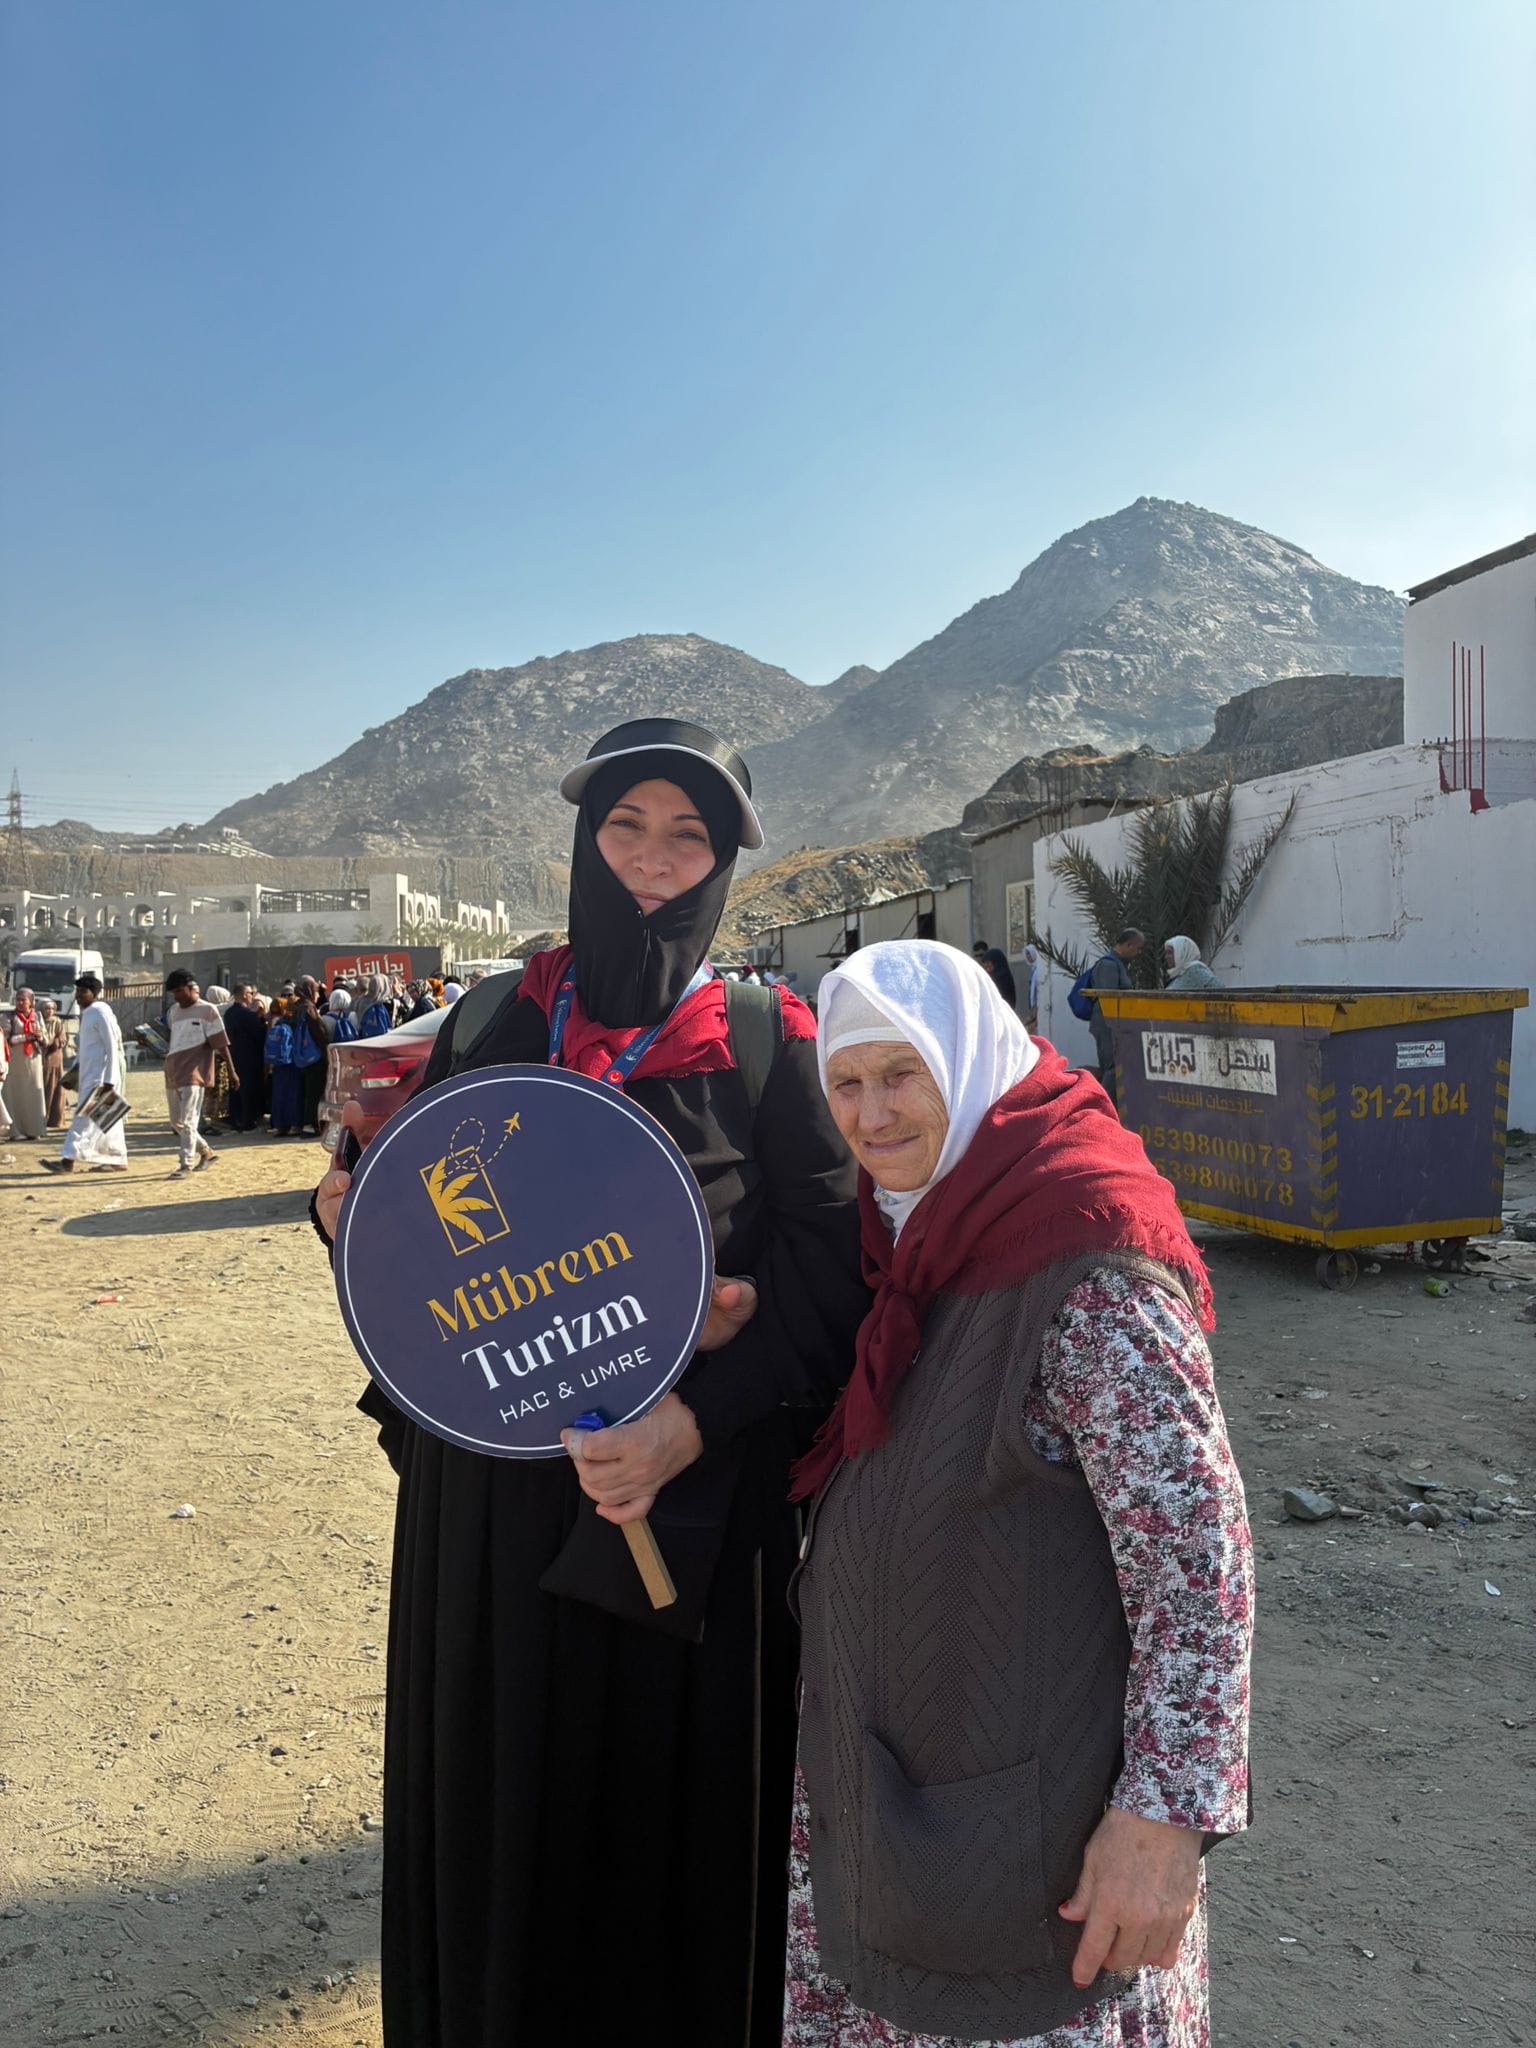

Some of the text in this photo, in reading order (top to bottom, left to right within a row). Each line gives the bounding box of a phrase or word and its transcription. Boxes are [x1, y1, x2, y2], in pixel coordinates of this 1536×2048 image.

[1350, 1081, 1468, 1120] 31-2184
[1138, 1123, 1293, 1172] 0539800073
[1155, 1157, 1295, 1207] 539800078
[426, 1231, 635, 1343] Mübrem
[461, 1294, 649, 1391] Turizm
[500, 1345, 652, 1425] HAC & UMRE
